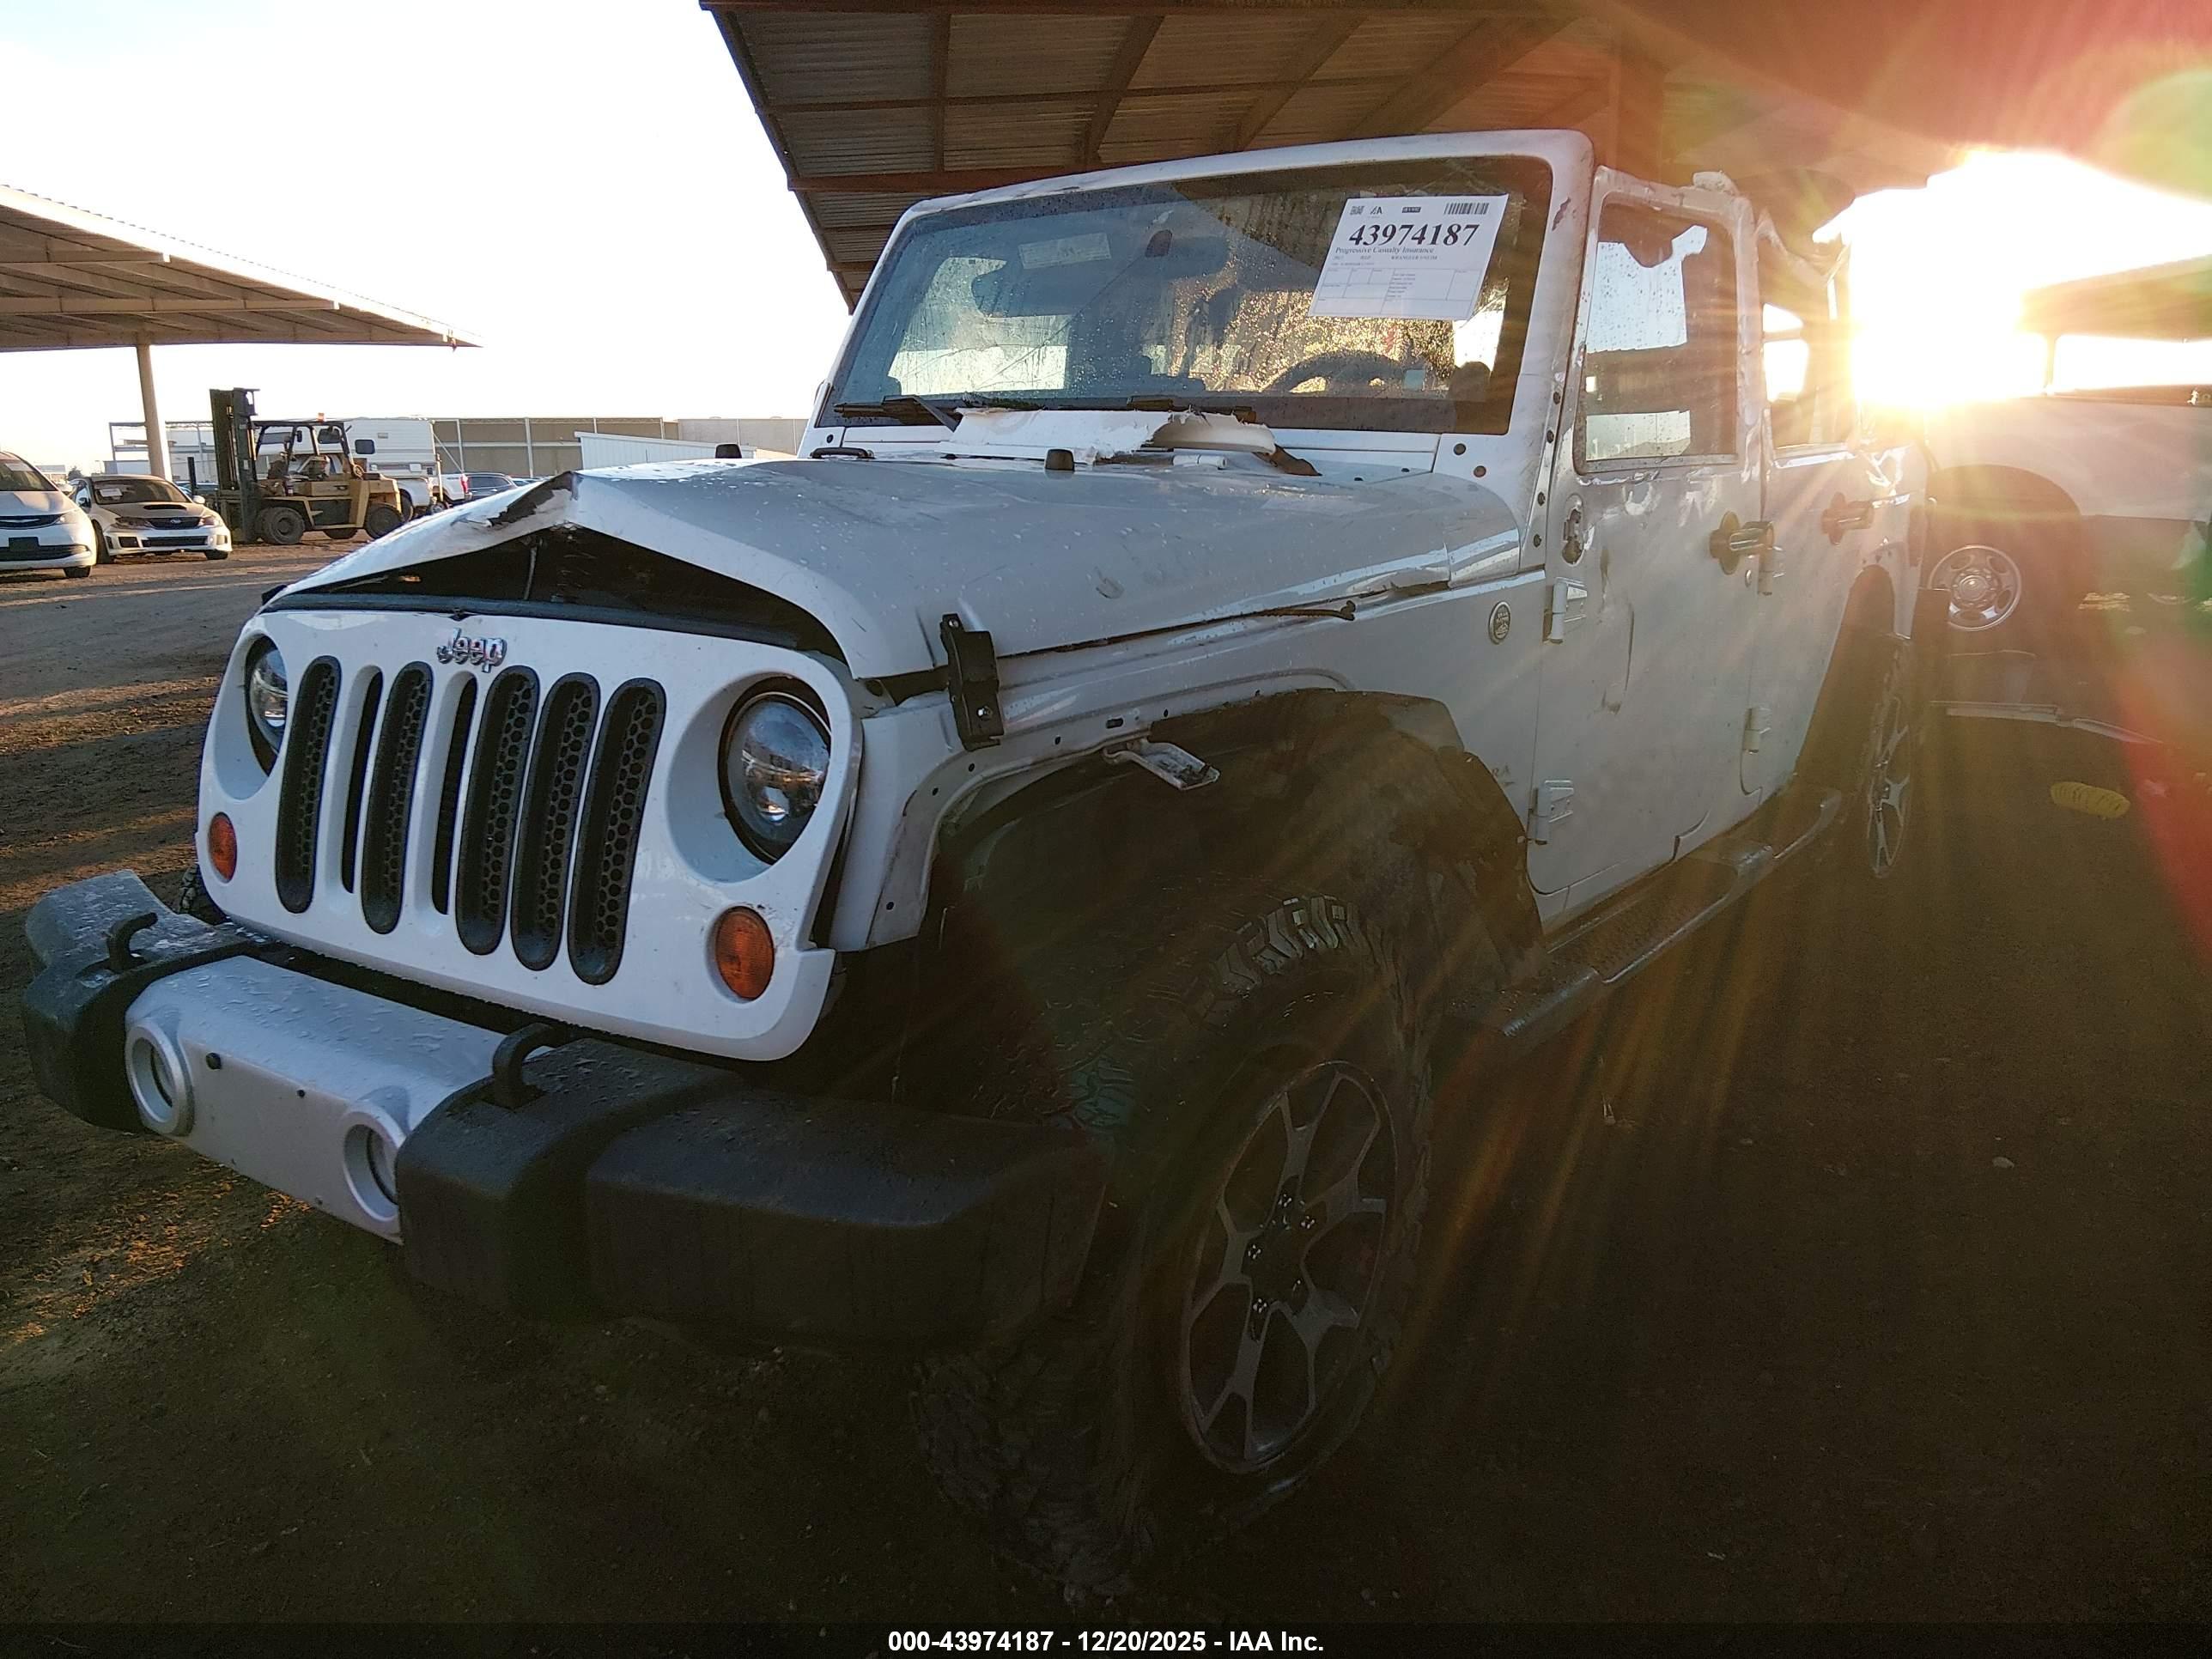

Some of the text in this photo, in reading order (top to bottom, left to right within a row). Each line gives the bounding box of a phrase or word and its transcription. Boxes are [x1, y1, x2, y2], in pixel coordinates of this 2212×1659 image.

[1349, 223, 1480, 246] 43974187
[1335, 246, 1372, 255] Progressive
[436, 627, 507, 673] Jeep
